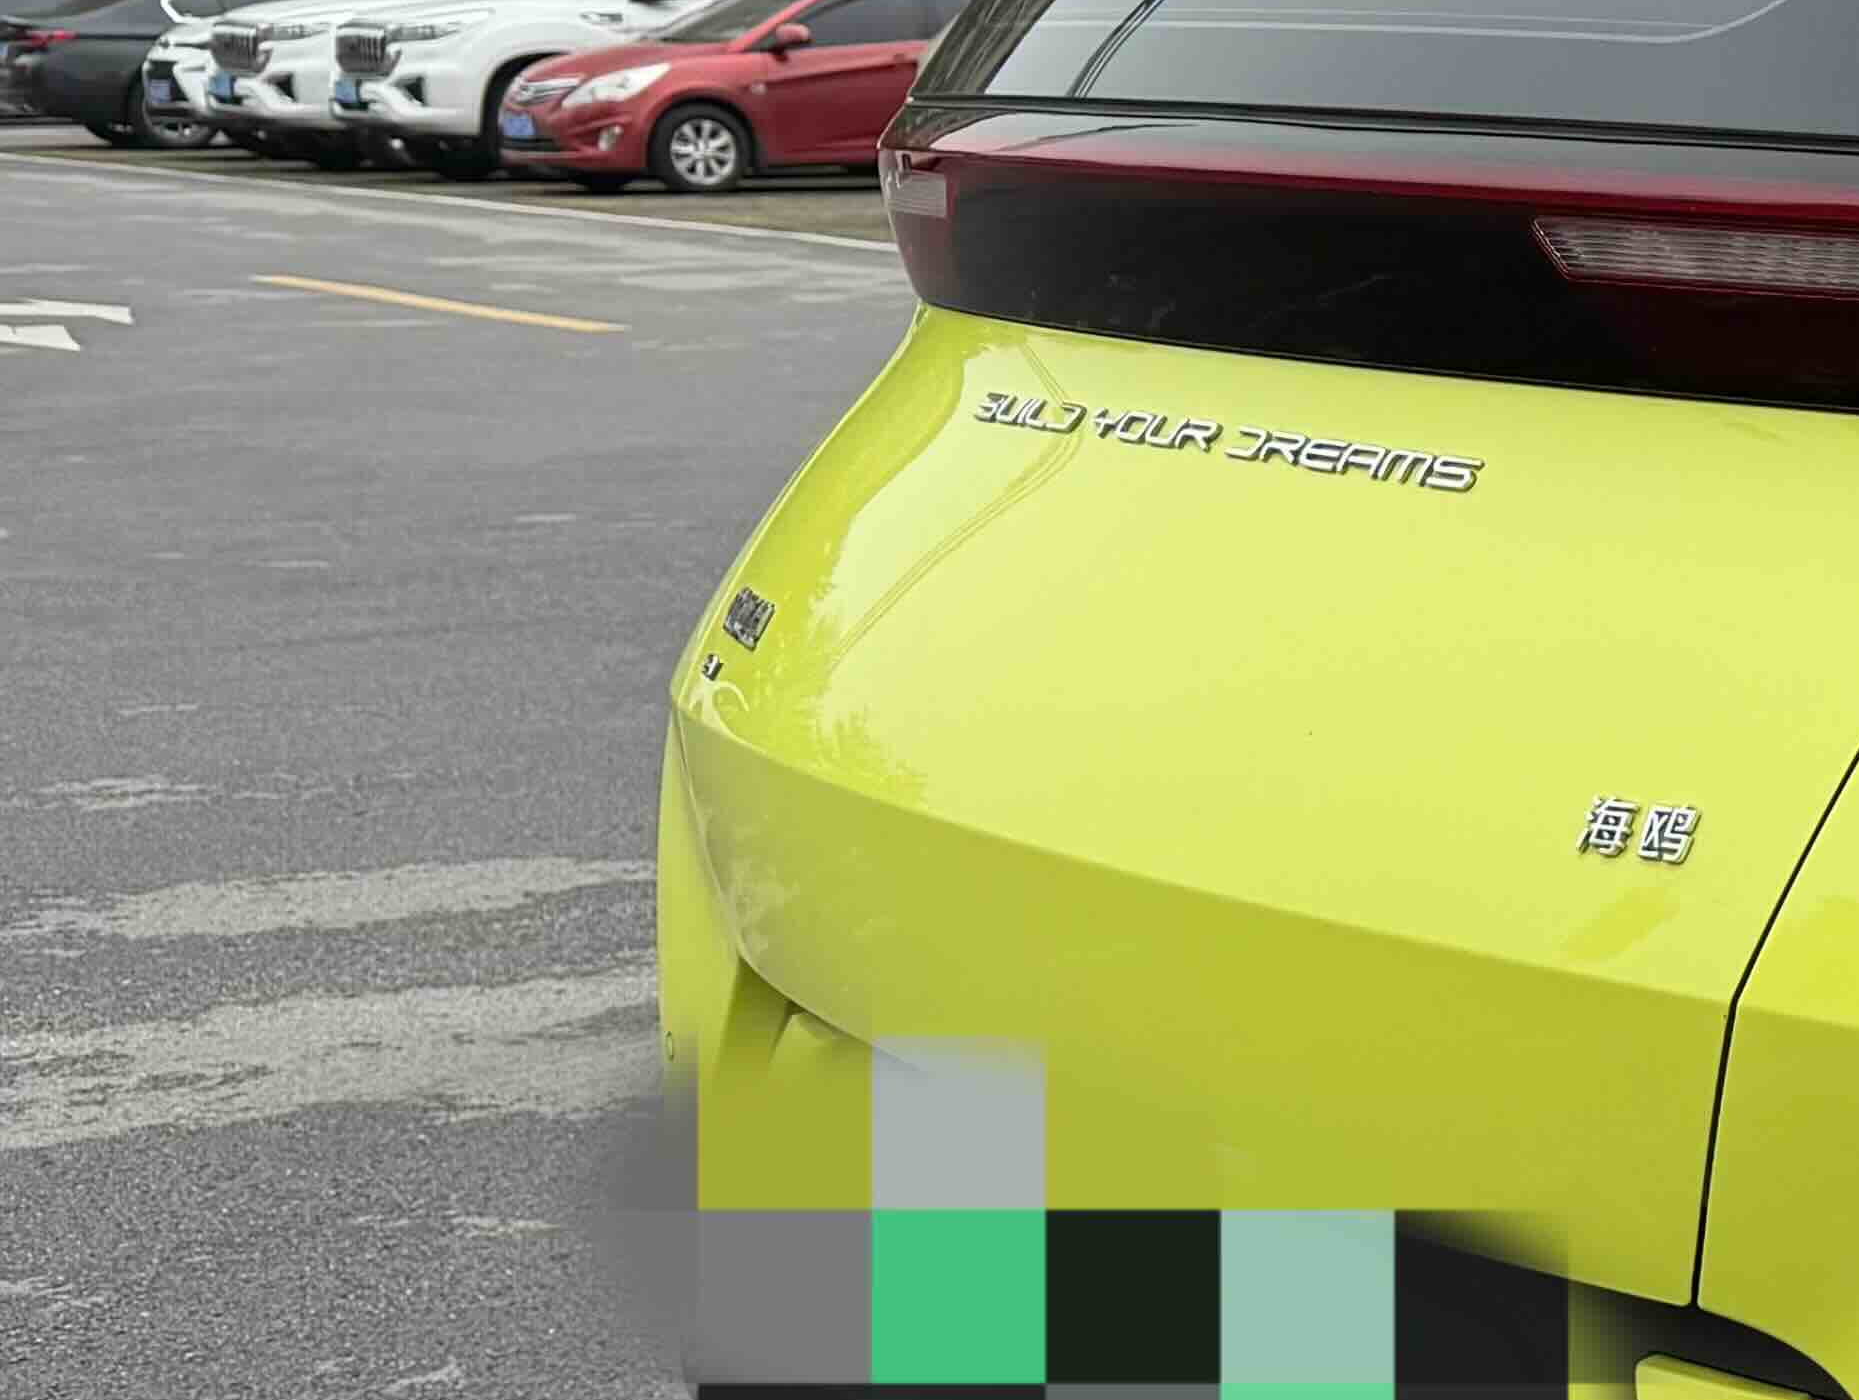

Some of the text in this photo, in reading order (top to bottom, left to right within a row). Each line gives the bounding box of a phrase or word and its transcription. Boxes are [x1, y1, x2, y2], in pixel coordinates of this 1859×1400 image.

[974, 391, 1487, 493] BUILD YOUR DREAMS
[1576, 793, 1702, 866] 海鸥
